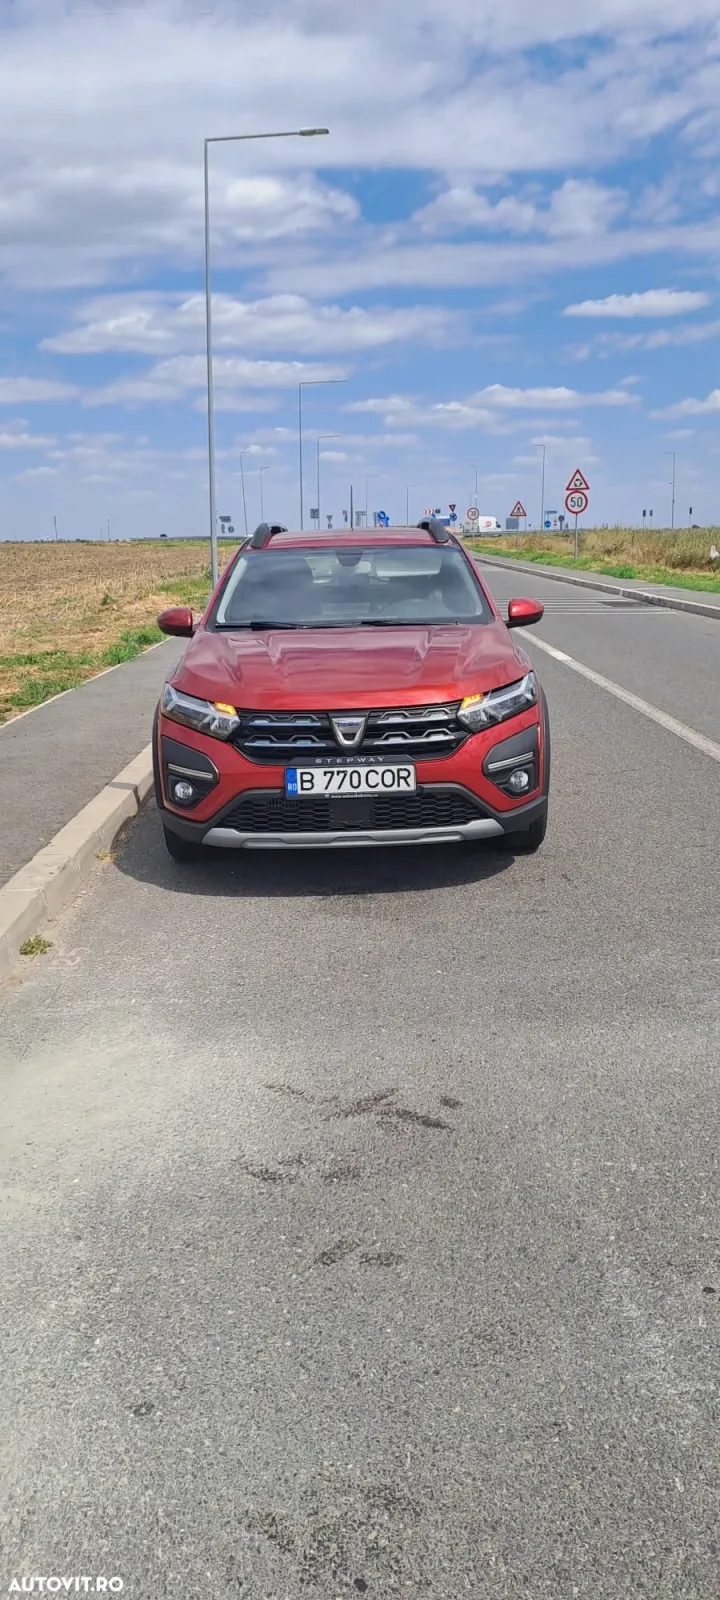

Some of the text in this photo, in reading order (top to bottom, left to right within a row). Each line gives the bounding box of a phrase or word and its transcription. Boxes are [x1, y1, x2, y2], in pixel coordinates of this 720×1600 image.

[570, 496, 583, 508] 50
[315, 756, 385, 764] STEPWAY
[300, 768, 411, 791] B 770 COR
[288, 783, 297, 791] RO
